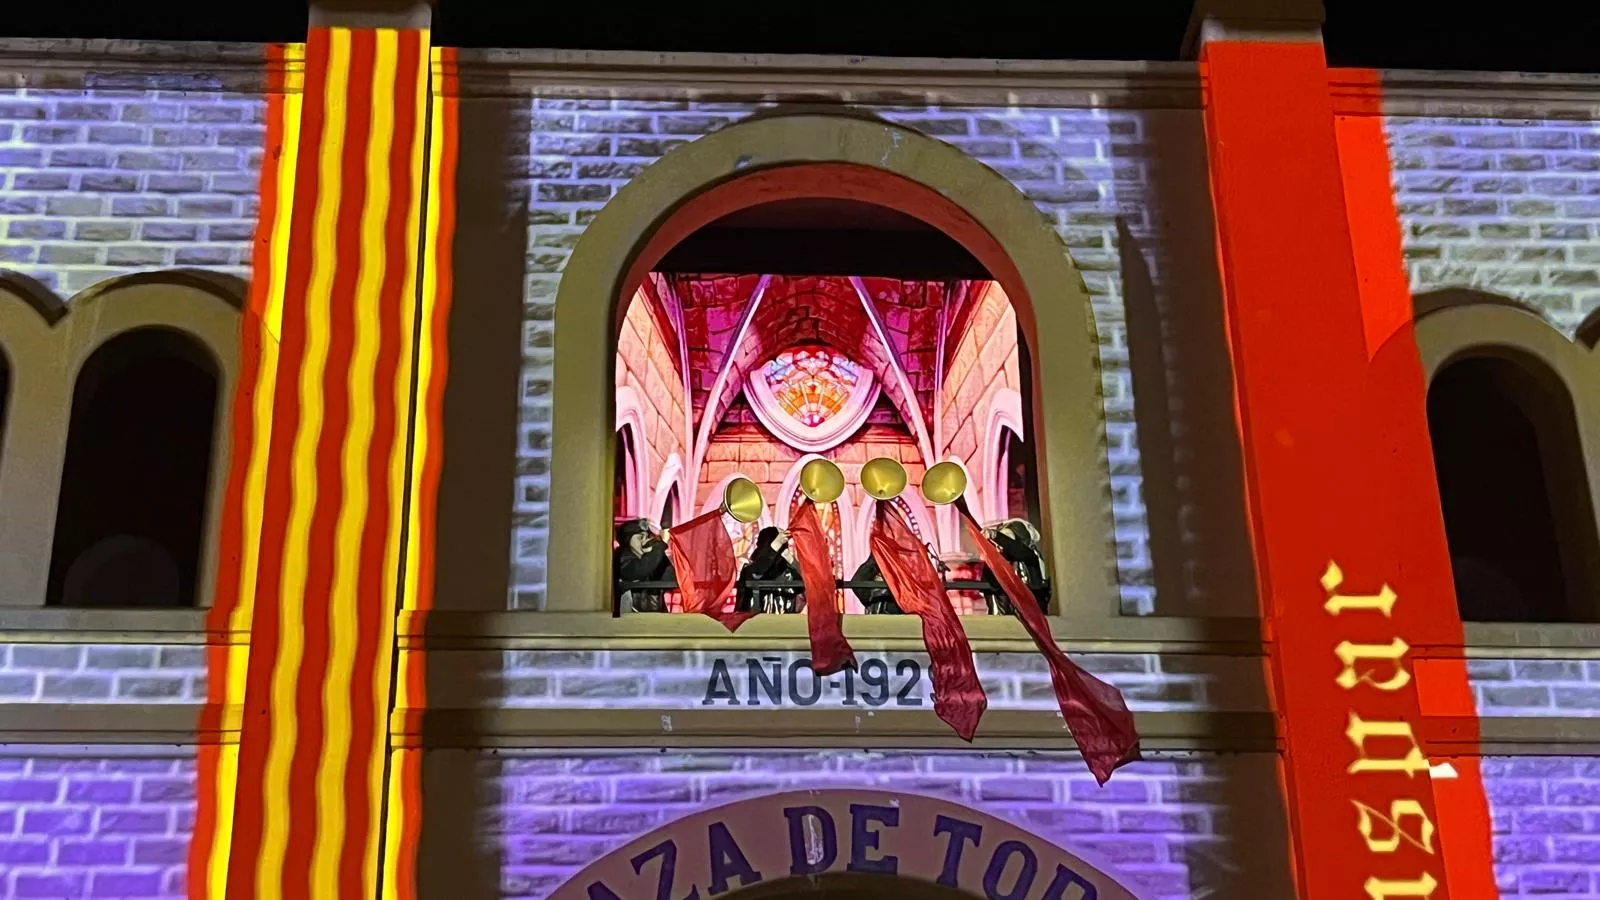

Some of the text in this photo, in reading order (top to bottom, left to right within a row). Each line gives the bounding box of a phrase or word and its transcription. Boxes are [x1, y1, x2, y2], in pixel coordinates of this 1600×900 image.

[702, 657, 937, 706] AÑO-192
[587, 821, 762, 900] ZA
[784, 803, 899, 876] DE
